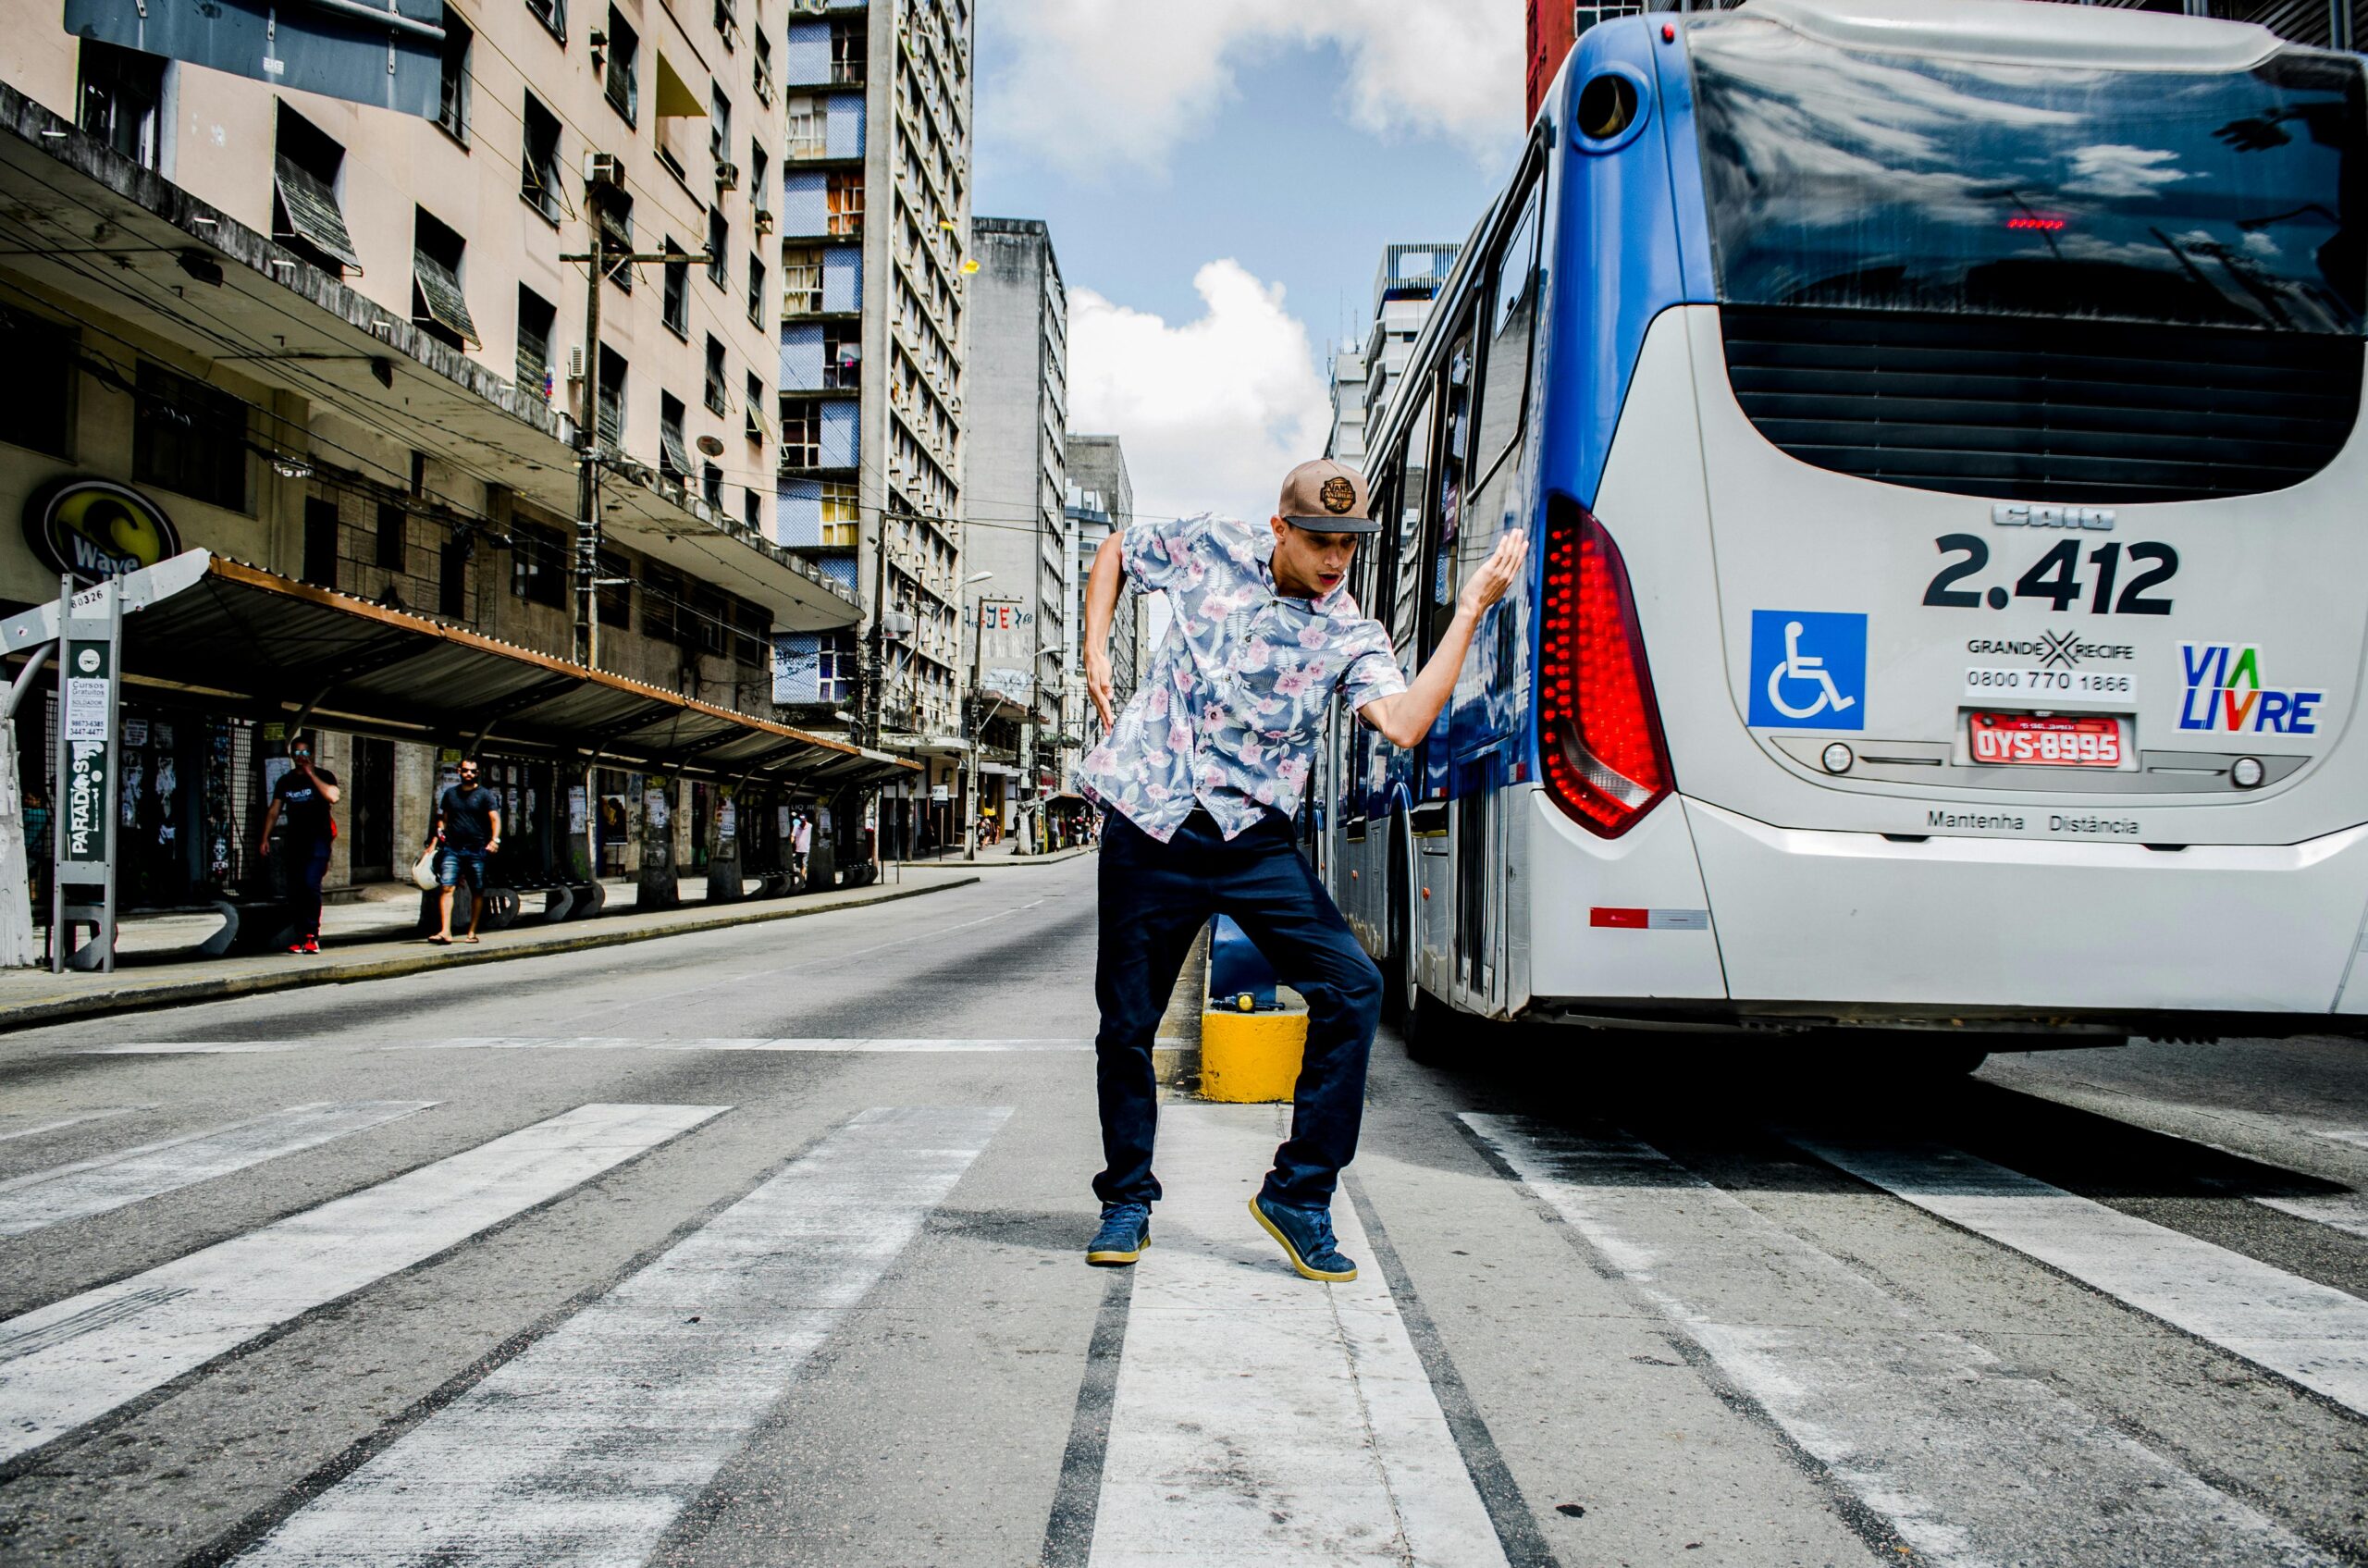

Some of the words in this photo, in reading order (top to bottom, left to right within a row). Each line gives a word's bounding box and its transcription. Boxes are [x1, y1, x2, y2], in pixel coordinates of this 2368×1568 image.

[1993, 503, 2115, 530] CAIO
[73, 533, 139, 574] Wave
[1921, 533, 2180, 615] 2.412
[71, 589, 103, 609] 80326
[1967, 639, 2044, 656] GRANDE
[2075, 645, 2135, 660] RECIFE
[2182, 646, 2260, 689] VIA
[72, 681, 105, 689] Cursos
[1967, 671, 2018, 687] 0800
[2028, 672, 2071, 689] 770
[2079, 676, 2129, 692] 1866
[2179, 687, 2323, 734] LIVRE
[1977, 730, 2118, 761] OYS-8995
[1927, 810, 2025, 831] Mantenha
[2049, 815, 2140, 834] Distância
